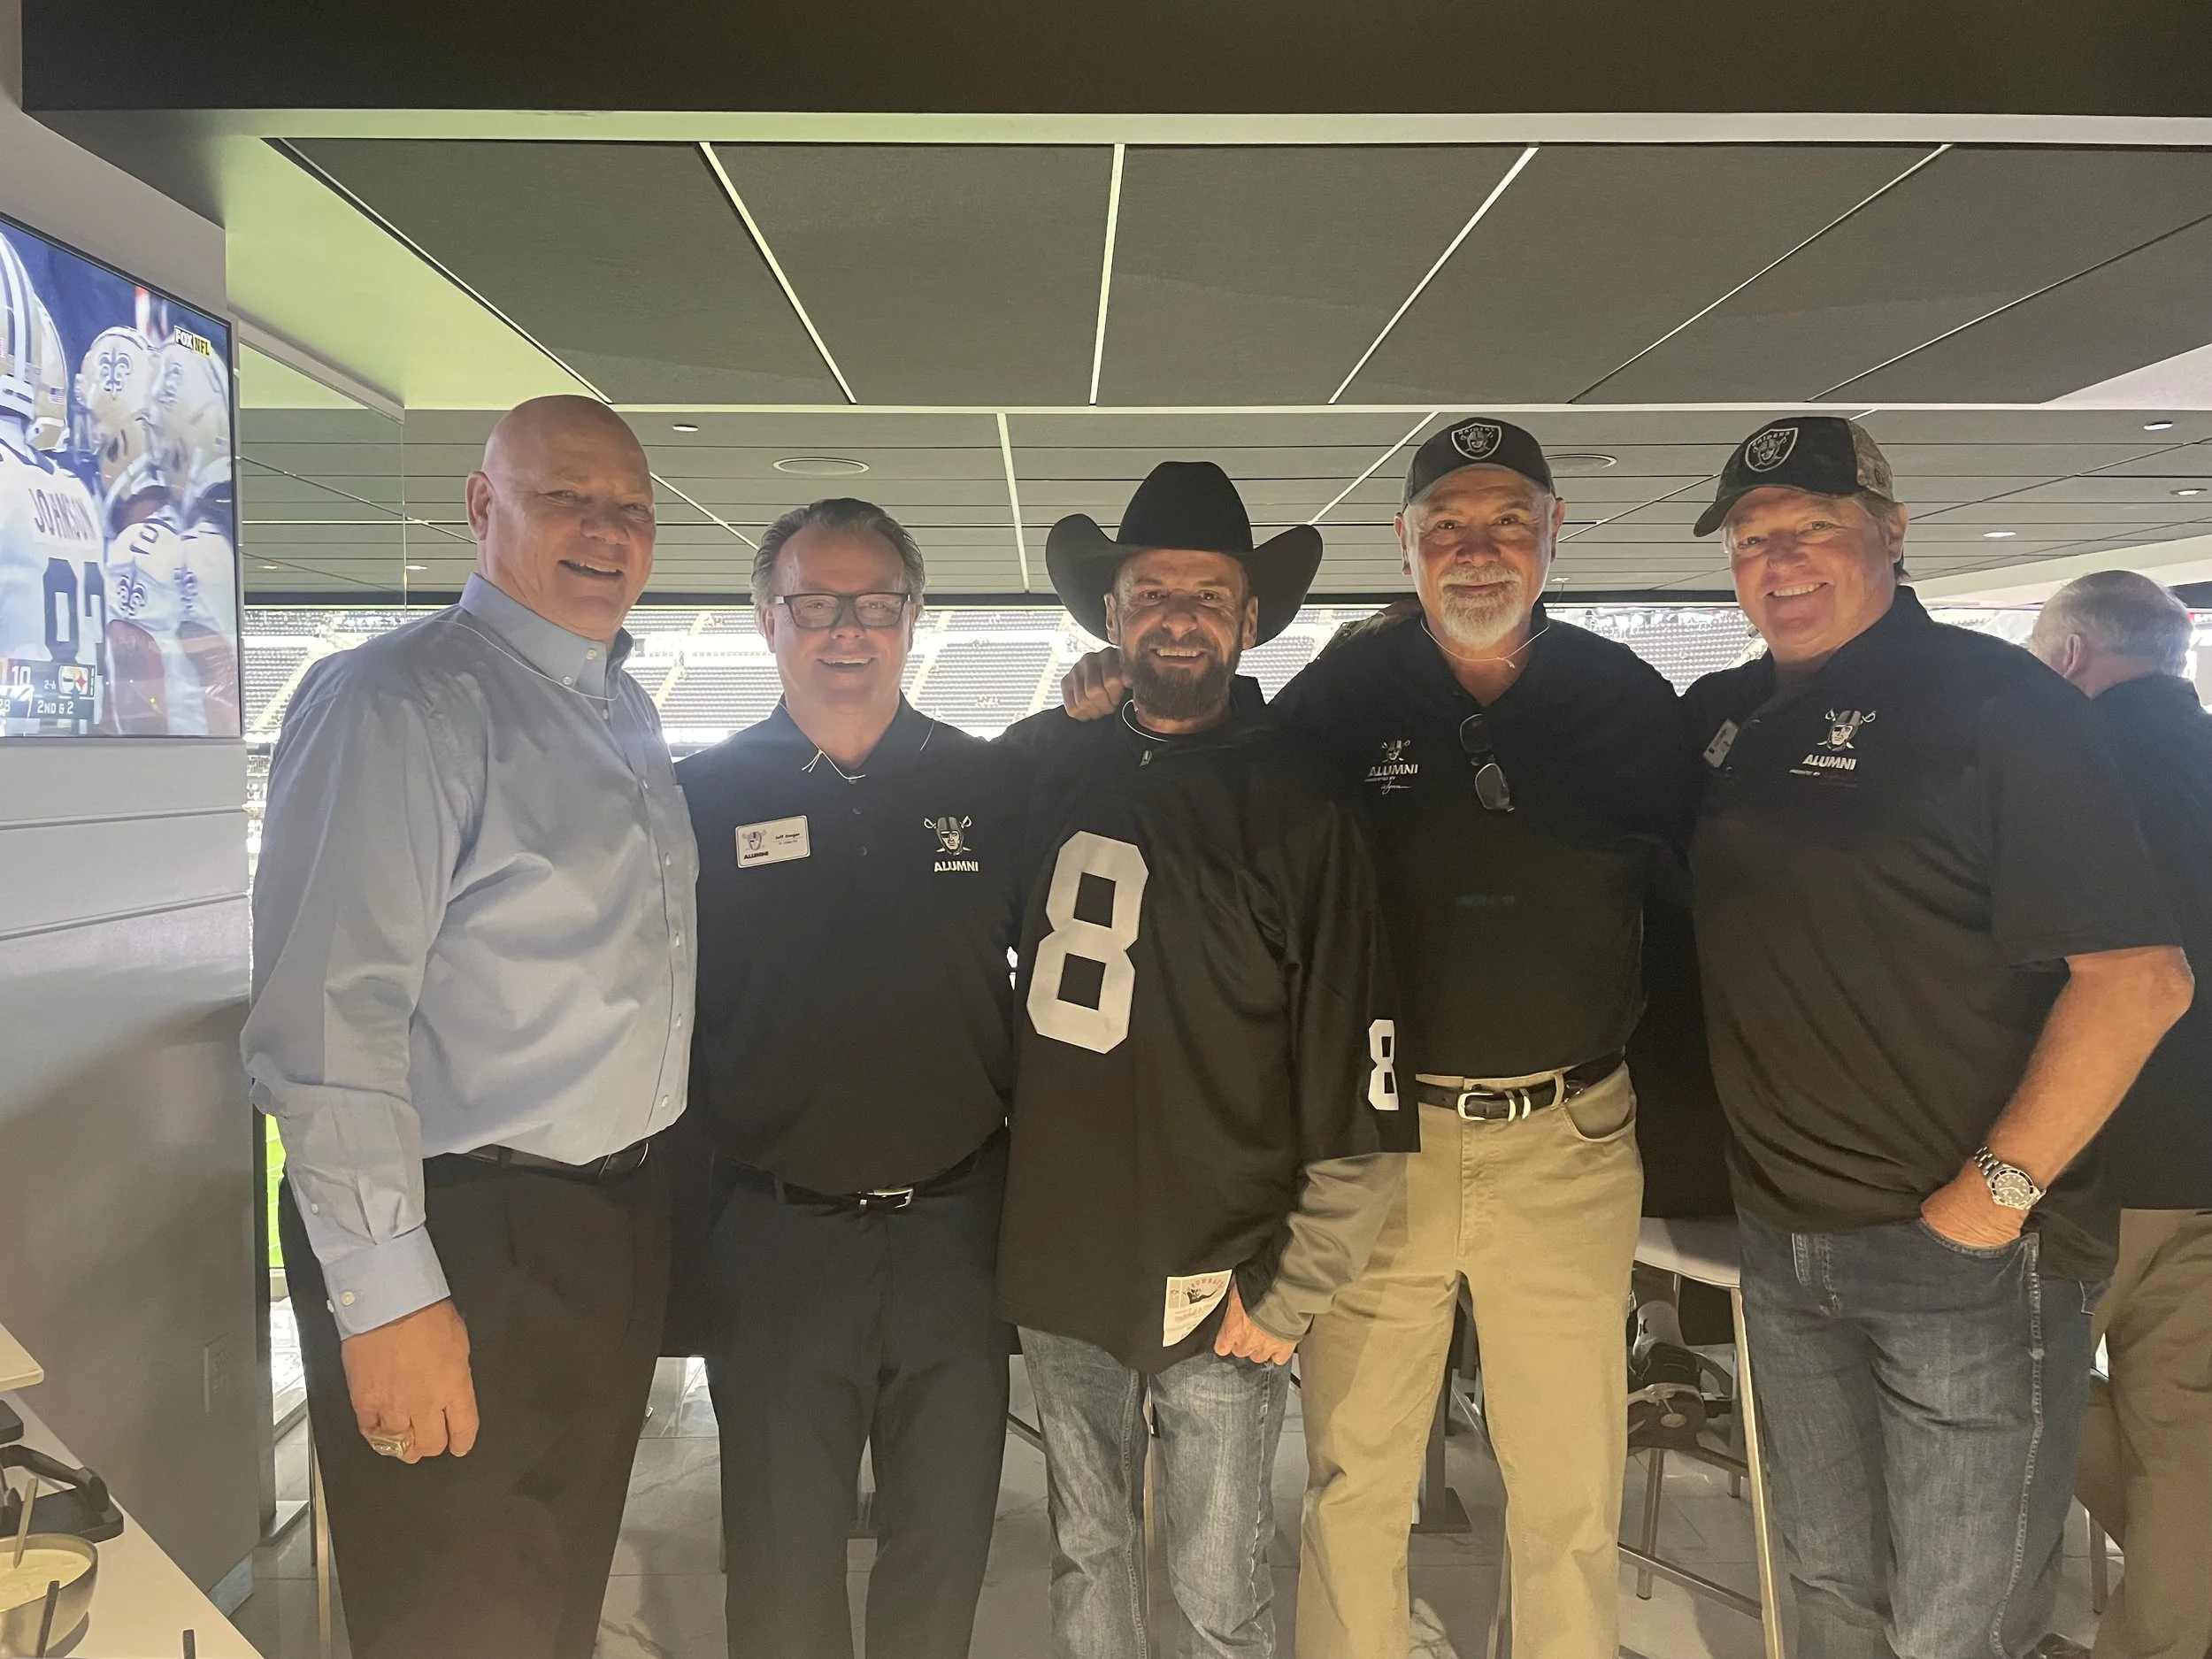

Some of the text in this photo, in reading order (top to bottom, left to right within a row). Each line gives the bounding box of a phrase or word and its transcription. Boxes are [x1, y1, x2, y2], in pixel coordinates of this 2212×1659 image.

[175, 328, 211, 356] FOX NFL
[12, 665, 31, 686] 10
[37, 700, 57, 714] 2ND
[66, 701, 74, 715] 2
[1368, 764, 1418, 778] ALUMNI
[1801, 754, 1857, 771] ALUMNI
[933, 860, 979, 872] ALUMNI
[1026, 830, 1149, 1055] 8
[1368, 1019, 1399, 1110] 8
